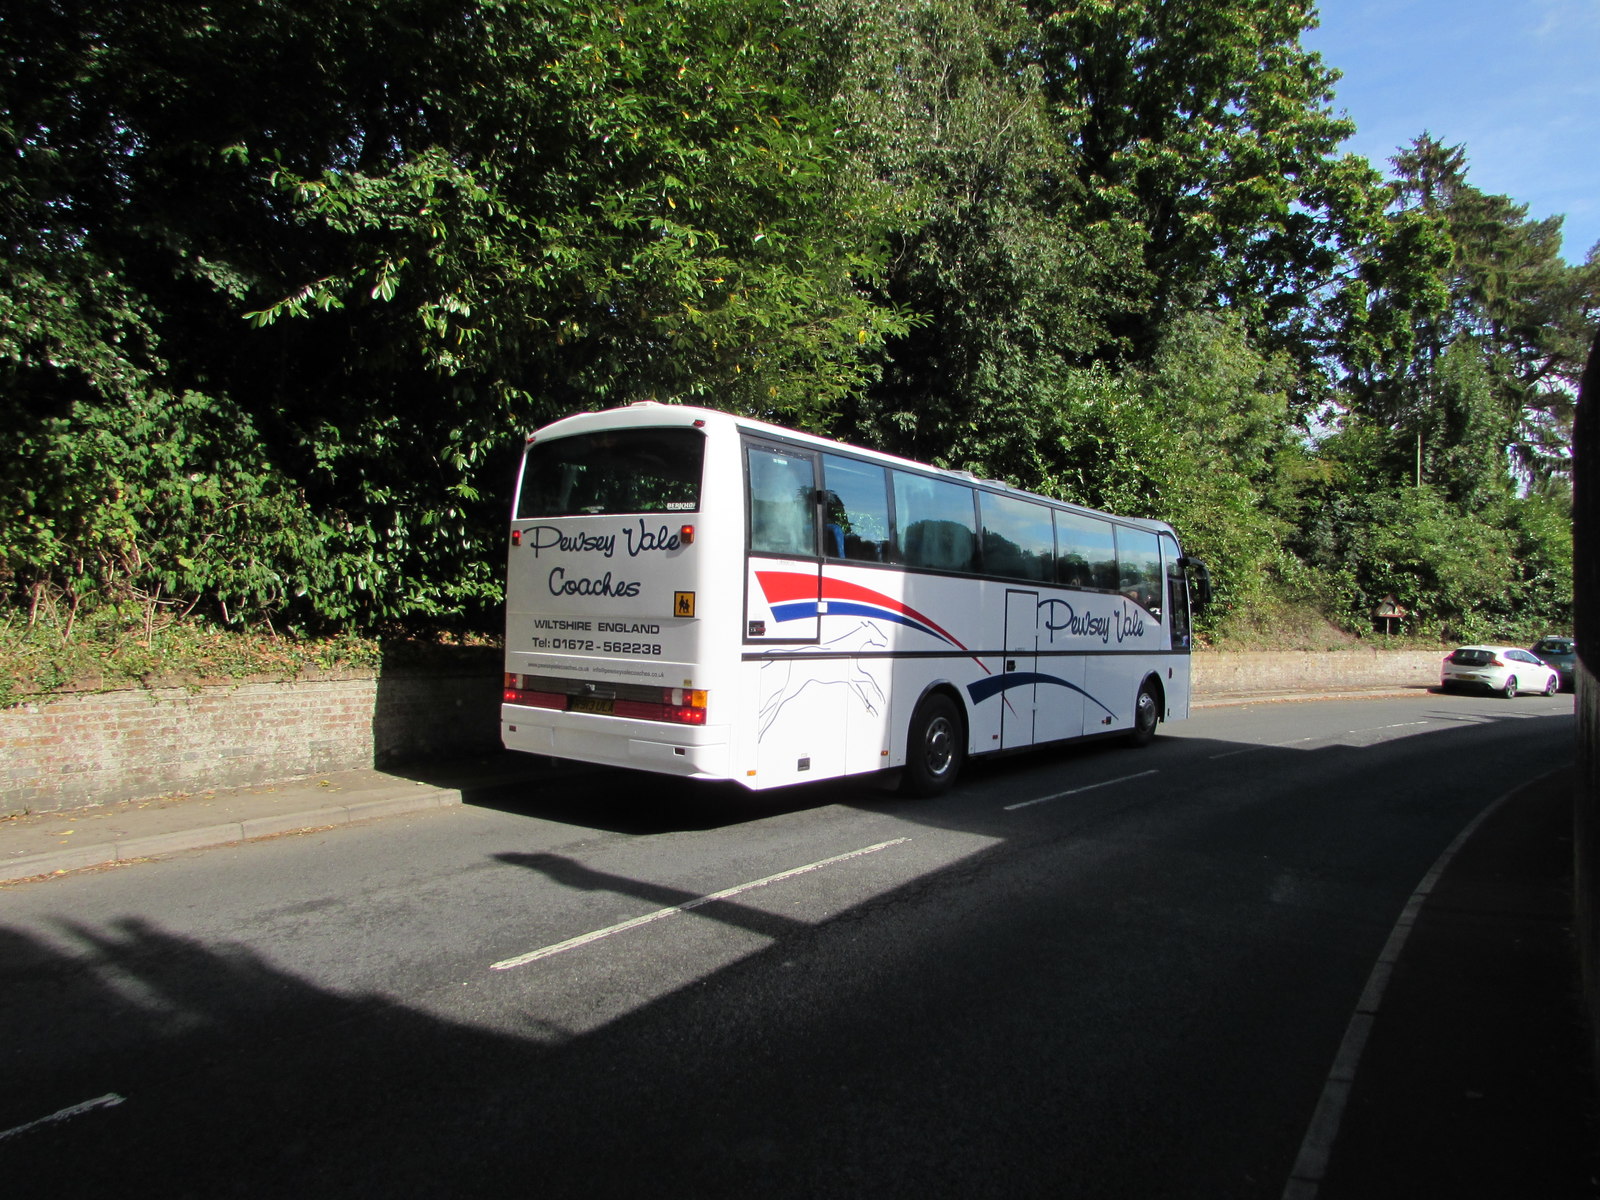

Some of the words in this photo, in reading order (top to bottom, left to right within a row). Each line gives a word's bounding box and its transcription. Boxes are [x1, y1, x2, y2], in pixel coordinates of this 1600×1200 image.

[523, 525, 616, 558] Pewsey
[623, 518, 681, 557] Vale
[549, 567, 641, 597] Coaches
[534, 620, 592, 631] WILTSHIRE
[598, 622, 660, 634] ENGLAND
[1037, 599, 1110, 644] Pewsey
[1114, 600, 1144, 644] Vale
